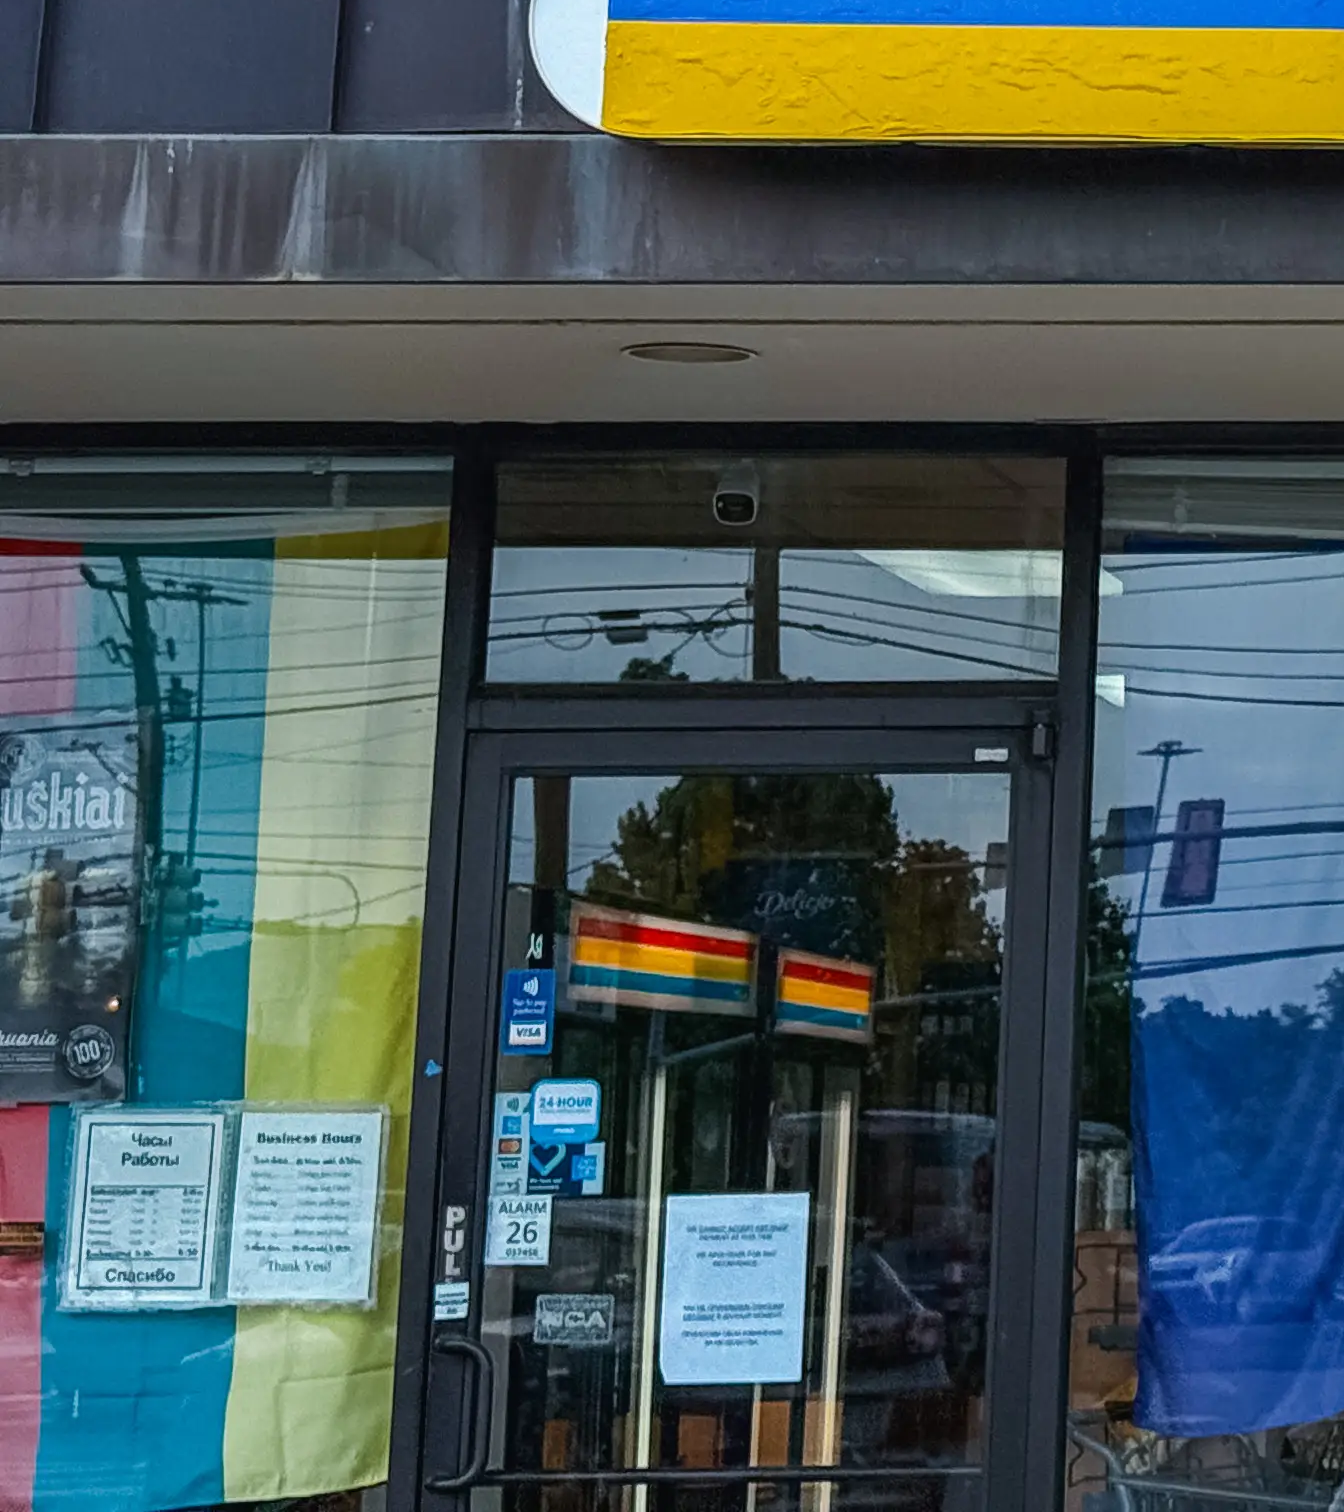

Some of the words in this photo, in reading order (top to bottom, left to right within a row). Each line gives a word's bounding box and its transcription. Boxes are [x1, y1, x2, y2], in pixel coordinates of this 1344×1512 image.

[516, 1027, 541, 1037] VISA
[556, 1096, 593, 1108] HOUR
[131, 1132, 173, 1147] Часы
[256, 1132, 318, 1145] Business
[321, 1132, 363, 1145] Hours
[121, 1151, 180, 1167] Работы
[498, 1201, 548, 1214] ALARM
[505, 1220, 539, 1245] 26
[443, 1205, 466, 1284] PUL
[267, 1261, 301, 1273] Thank
[105, 1267, 176, 1284] Спасибо
